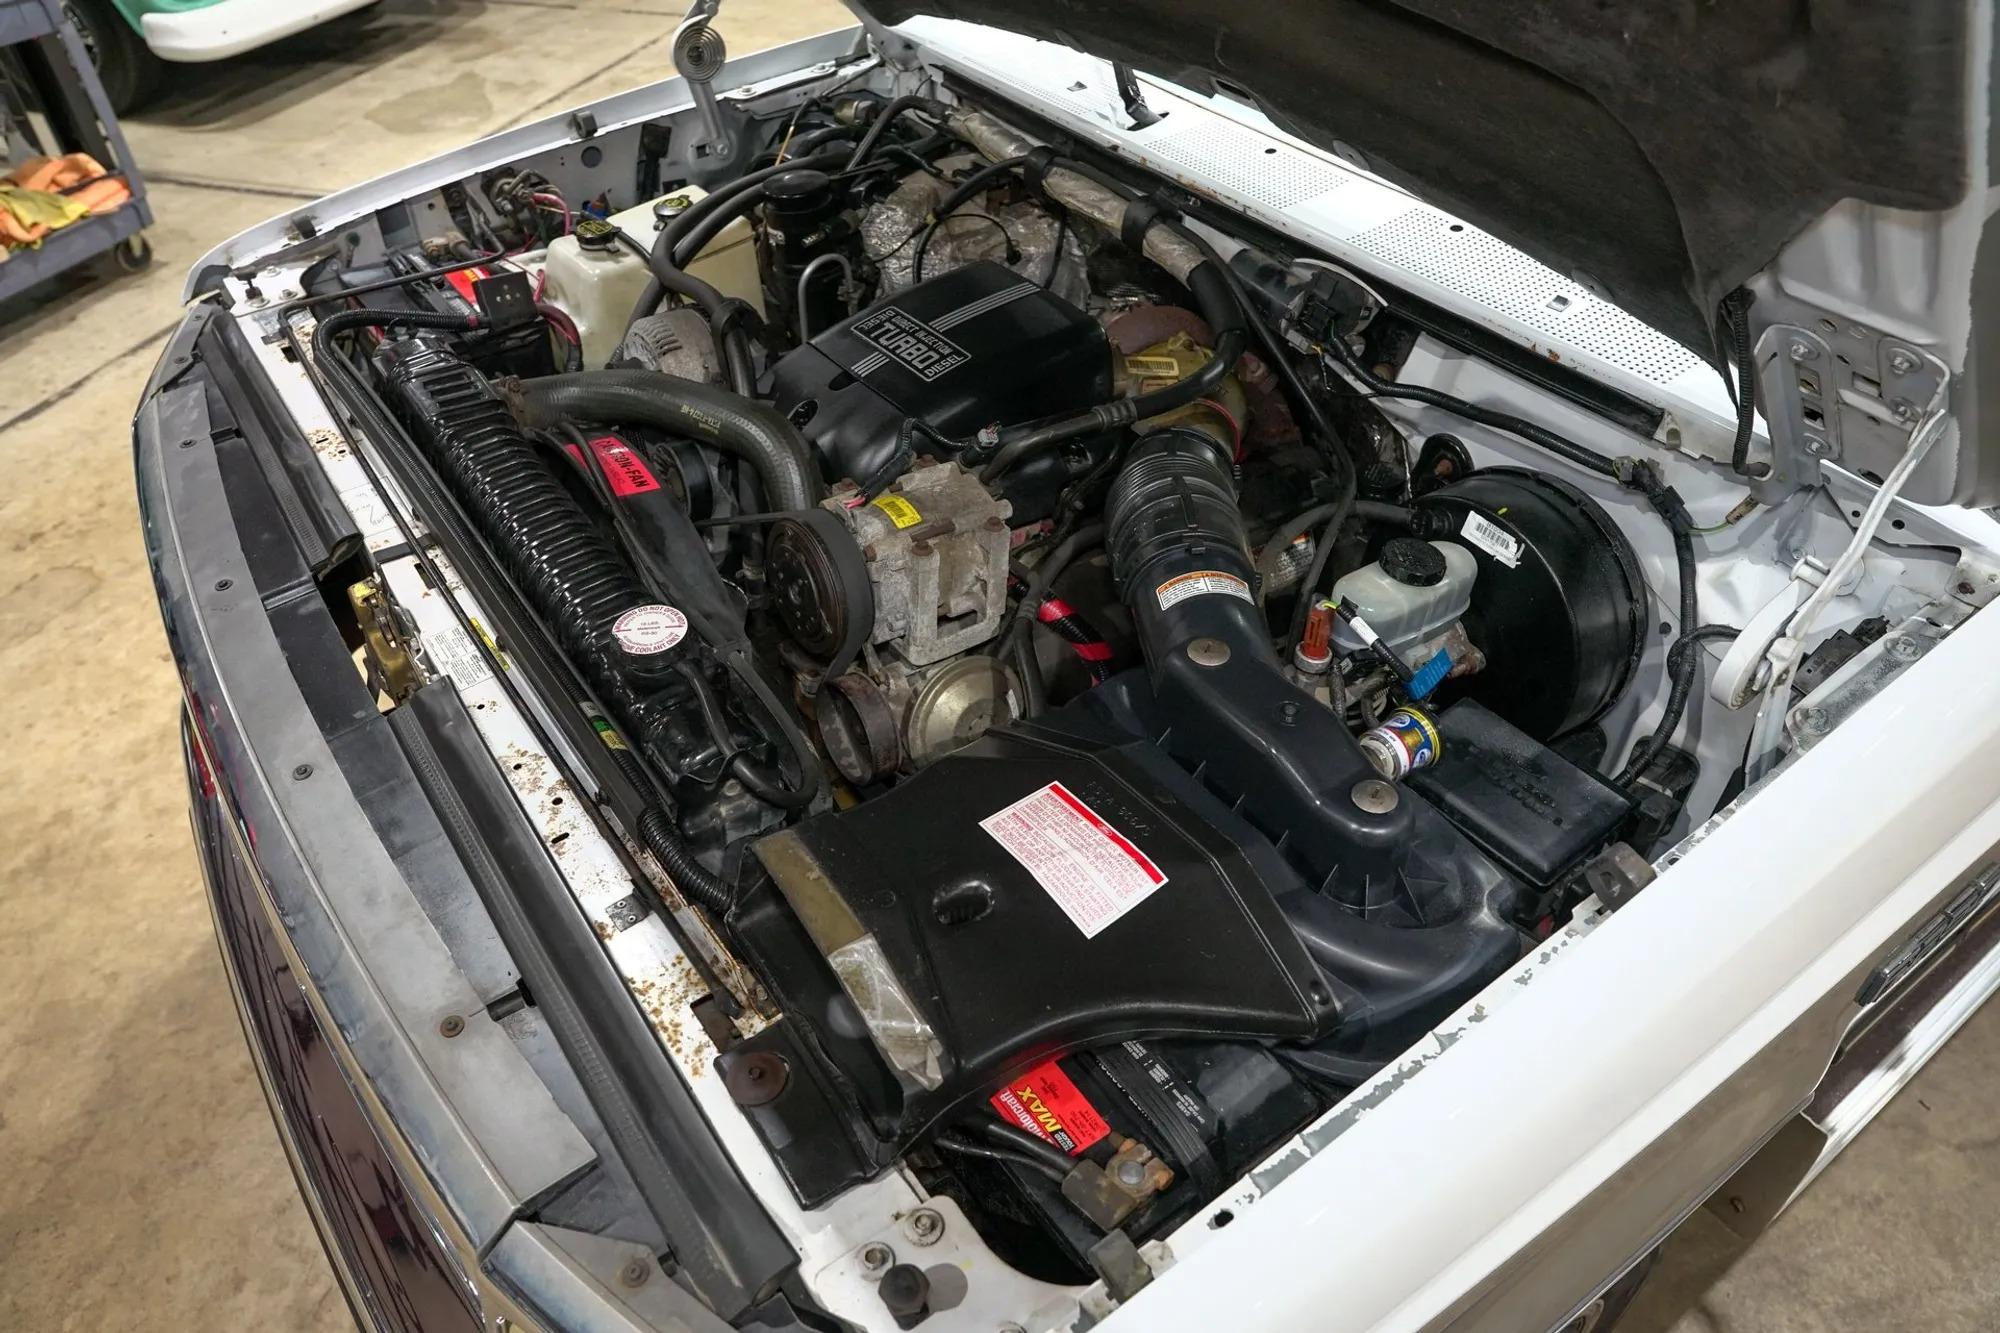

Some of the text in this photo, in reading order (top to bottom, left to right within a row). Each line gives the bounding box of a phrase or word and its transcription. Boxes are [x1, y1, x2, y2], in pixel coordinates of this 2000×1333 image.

[870, 322, 941, 370] TURBO
[925, 354, 964, 378] DIESEL
[1017, 1086, 1061, 1132] MAX
